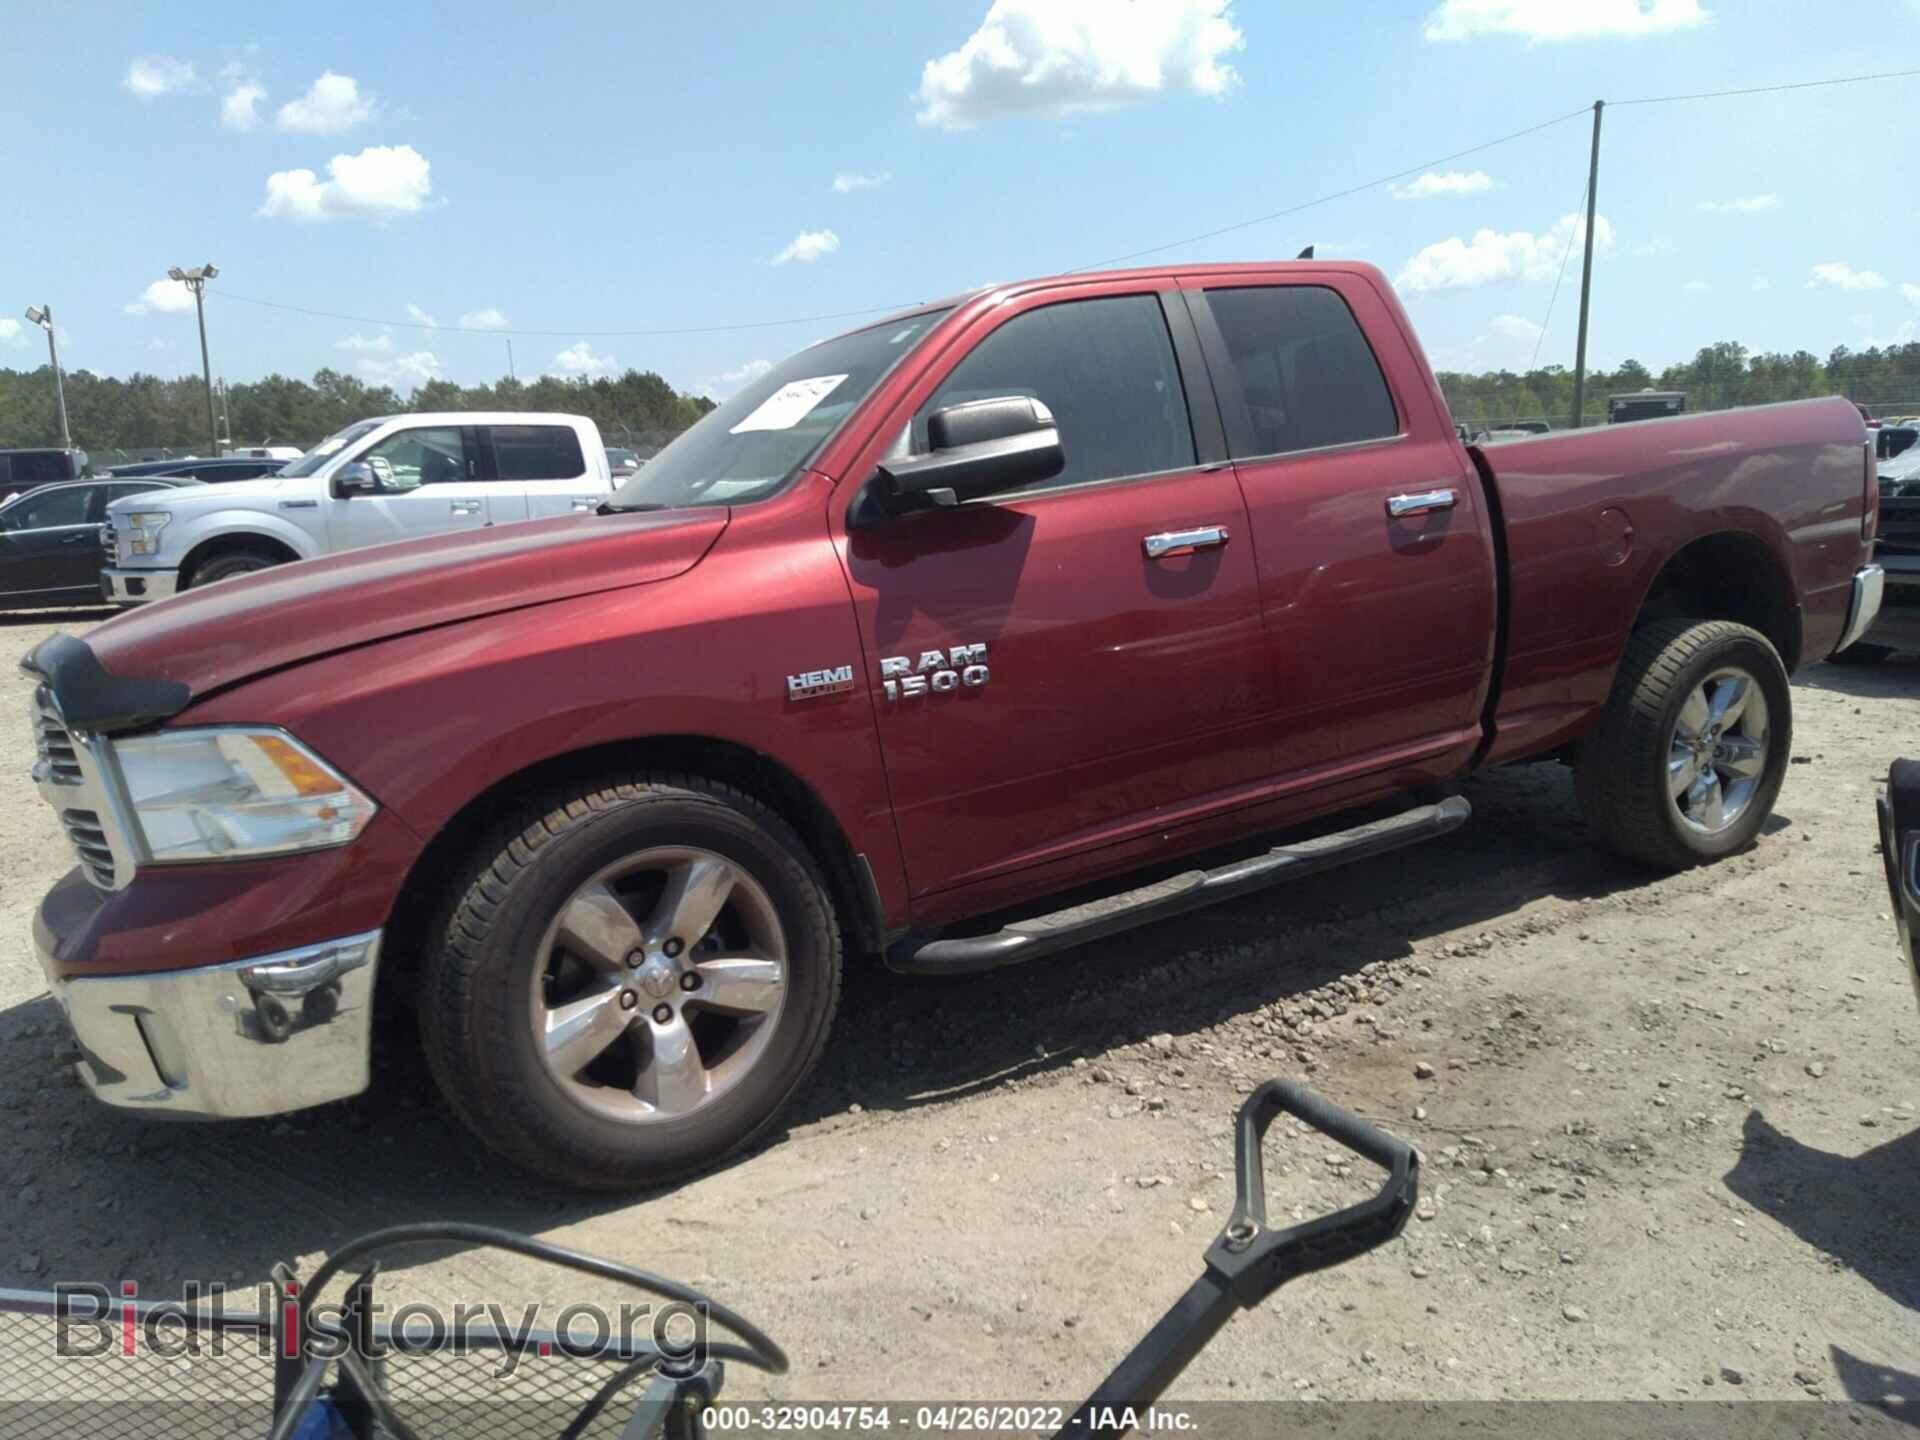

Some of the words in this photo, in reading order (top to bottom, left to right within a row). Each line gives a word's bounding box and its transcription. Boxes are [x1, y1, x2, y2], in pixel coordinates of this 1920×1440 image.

[786, 665, 853, 689] HEMI
[880, 643, 987, 677] RAM
[883, 665, 989, 700] 1500
